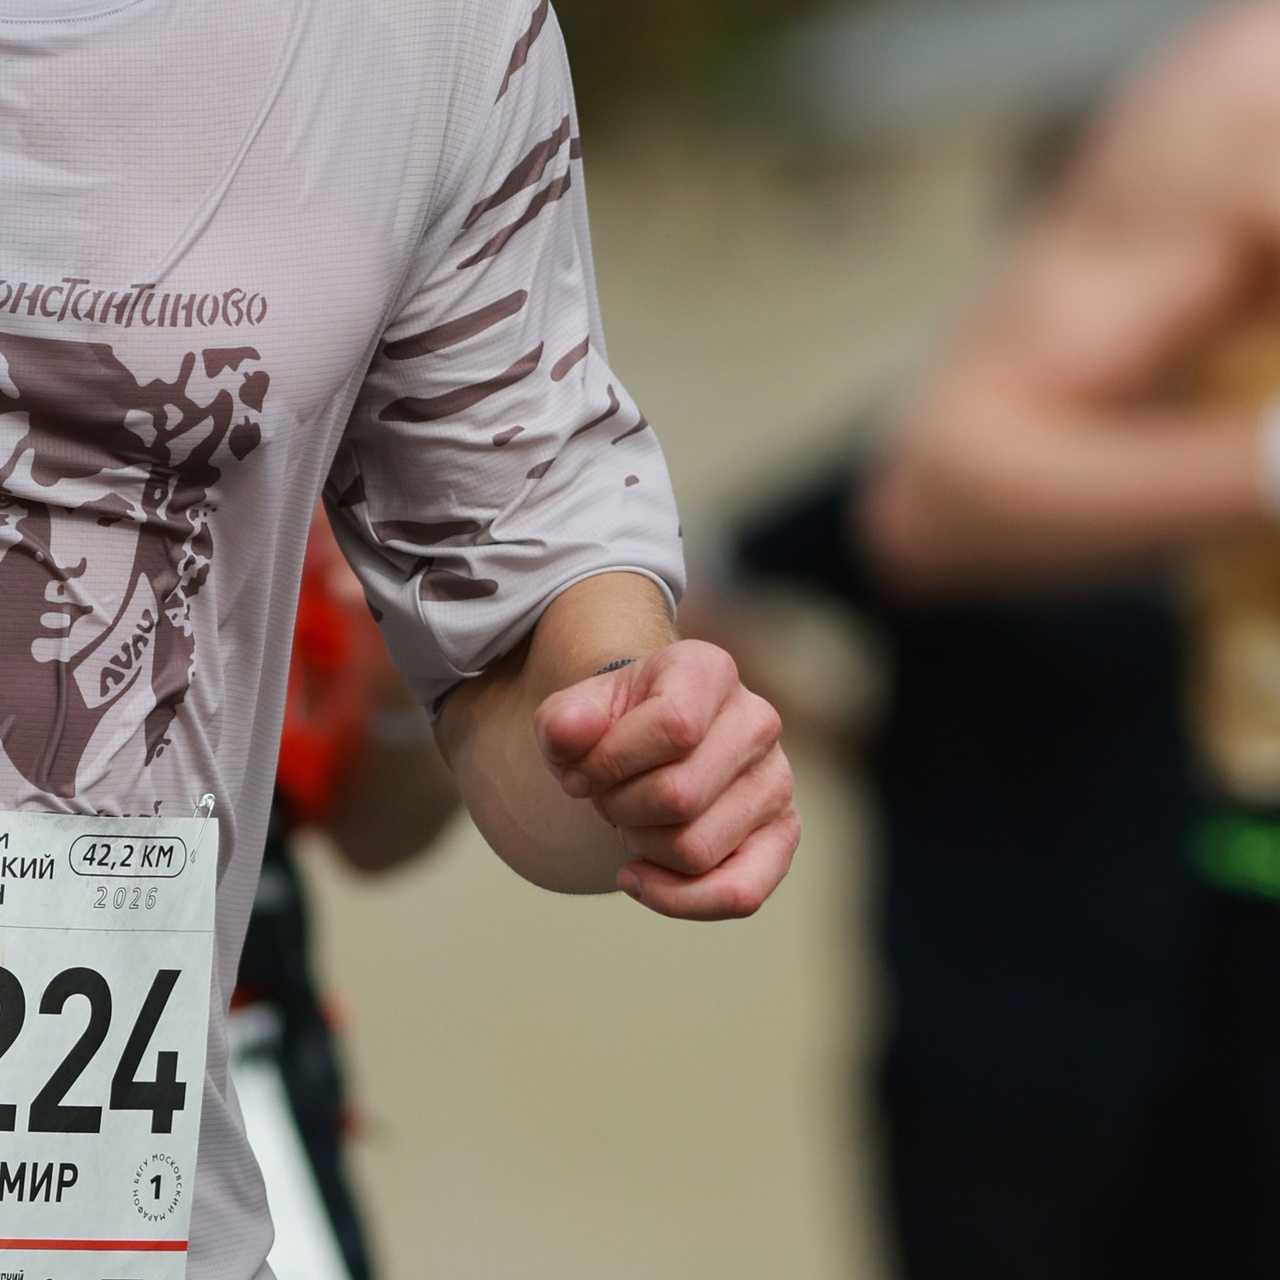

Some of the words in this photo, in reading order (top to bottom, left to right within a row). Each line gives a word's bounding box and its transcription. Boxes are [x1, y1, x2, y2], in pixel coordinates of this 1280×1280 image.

[82, 843, 133, 871] 42,2
[141, 844, 175, 868] КМ
[93, 886, 158, 910] 2026
[150, 1174, 162, 1200] 1
